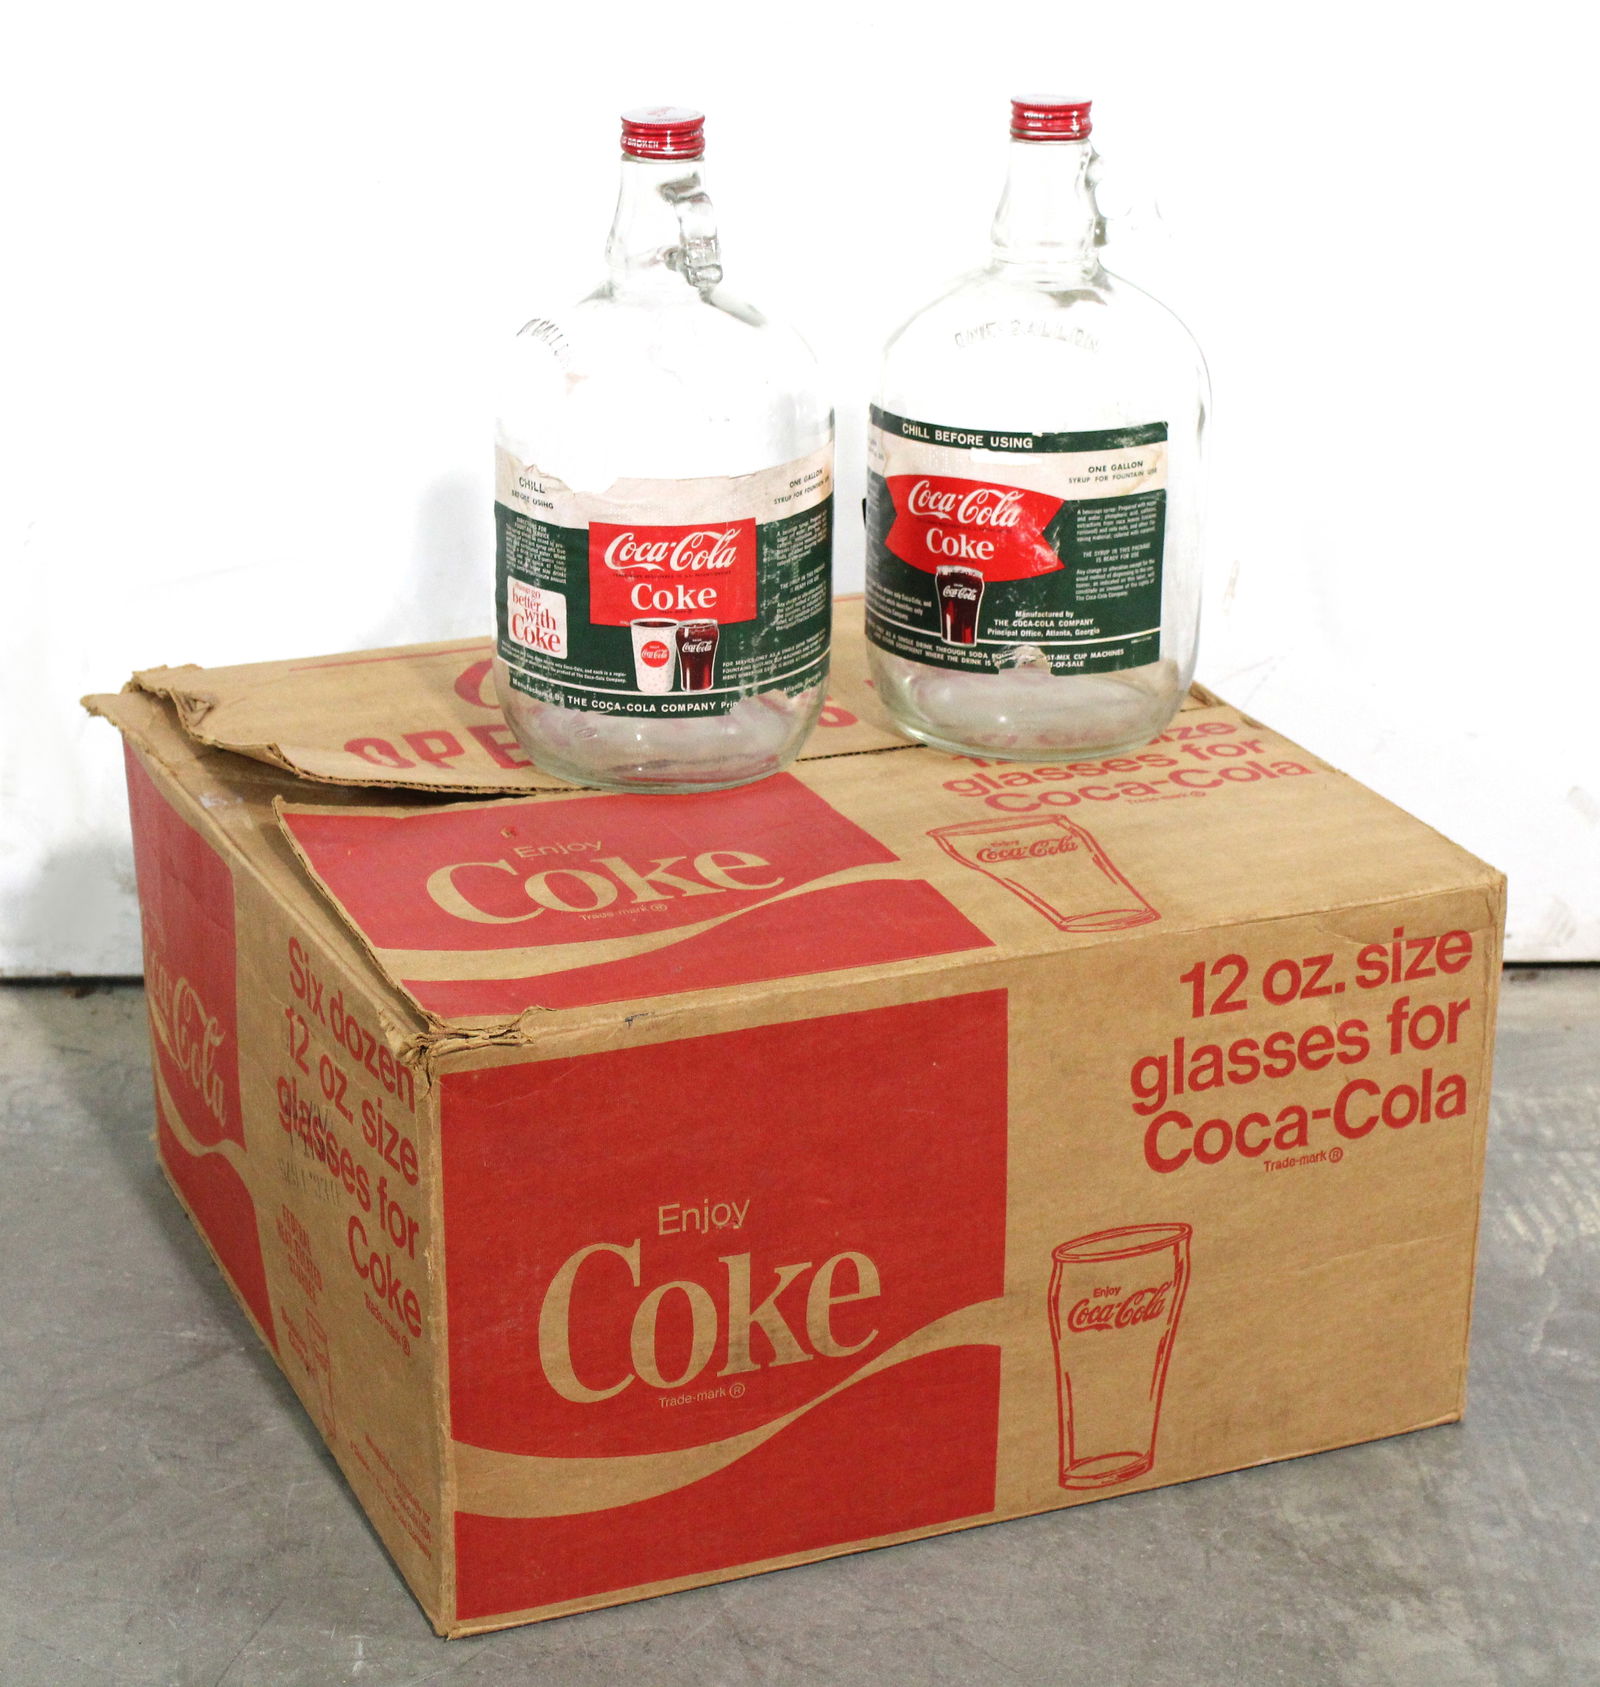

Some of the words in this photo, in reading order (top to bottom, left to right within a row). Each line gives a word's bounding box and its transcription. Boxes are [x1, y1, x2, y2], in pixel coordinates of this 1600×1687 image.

[902, 423, 930, 439] CHILL
[935, 429, 984, 446] BEFORE
[990, 436, 1033, 449] USING
[1088, 465, 1107, 474] ONE
[1111, 460, 1144, 471] GALLON
[1112, 471, 1144, 480] FOUNTAIN
[518, 476, 546, 494] CHILL
[789, 478, 802, 489] ONE
[532, 498, 554, 510] USING
[908, 479, 1025, 528] Coca-Cola
[604, 527, 743, 572] Coca-Cola
[926, 527, 995, 560] Coke
[512, 587, 541, 611] better
[630, 583, 718, 611] Coke
[942, 585, 978, 601] Coca-Cola
[524, 608, 557, 631] with
[994, 619, 1009, 627] THE
[1012, 619, 1055, 627] COCA-COLA
[1058, 618, 1095, 627] COMPANY
[1015, 610, 1064, 618] Manufactured
[1065, 610, 1074, 618] by
[512, 613, 561, 653] Coke
[987, 627, 1018, 637] Principal
[1020, 629, 1044, 638] Office,
[1045, 629, 1073, 638] Atlanta,
[1074, 627, 1101, 636] Georgia
[915, 641, 934, 651] DRINK
[935, 645, 966, 656] THROUGH
[968, 651, 988, 659] SODA
[924, 650, 945, 660] WHERE
[947, 655, 959, 663] THE
[961, 657, 982, 666] DRINK
[1090, 648, 1125, 659] MACHINES
[567, 695, 588, 707] THE
[592, 699, 657, 713] COCA-COLA
[661, 701, 716, 712] COMPANY
[344, 724, 537, 770] OPE
[942, 753, 1178, 798] glasses
[1182, 735, 1267, 767] for
[985, 757, 1317, 813] Coca-Cola
[513, 838, 603, 861] Enjoy
[976, 834, 1079, 864] Coca-Cola
[426, 849, 786, 925] Coke
[1180, 953, 1250, 1019] 12
[1262, 952, 1347, 1007] oz.
[1356, 926, 1474, 991] size
[288, 936, 326, 1025] Six
[329, 989, 416, 1114] dozen
[1130, 1018, 1371, 1117] glasses
[1387, 996, 1471, 1056] for
[284, 1007, 310, 1076] 12
[361, 1096, 420, 1186] size
[1143, 1068, 1468, 1175] Coca-Cola
[276, 1076, 372, 1213] glasses
[376, 1175, 420, 1261] for
[657, 1199, 751, 1236] Enjoy
[348, 1215, 422, 1338] Coke
[1093, 1285, 1122, 1299] Enjoy
[538, 1238, 882, 1404] Coke
[1067, 1280, 1173, 1334] Coca-Cola
[658, 1387, 728, 1410] Trade-mark
